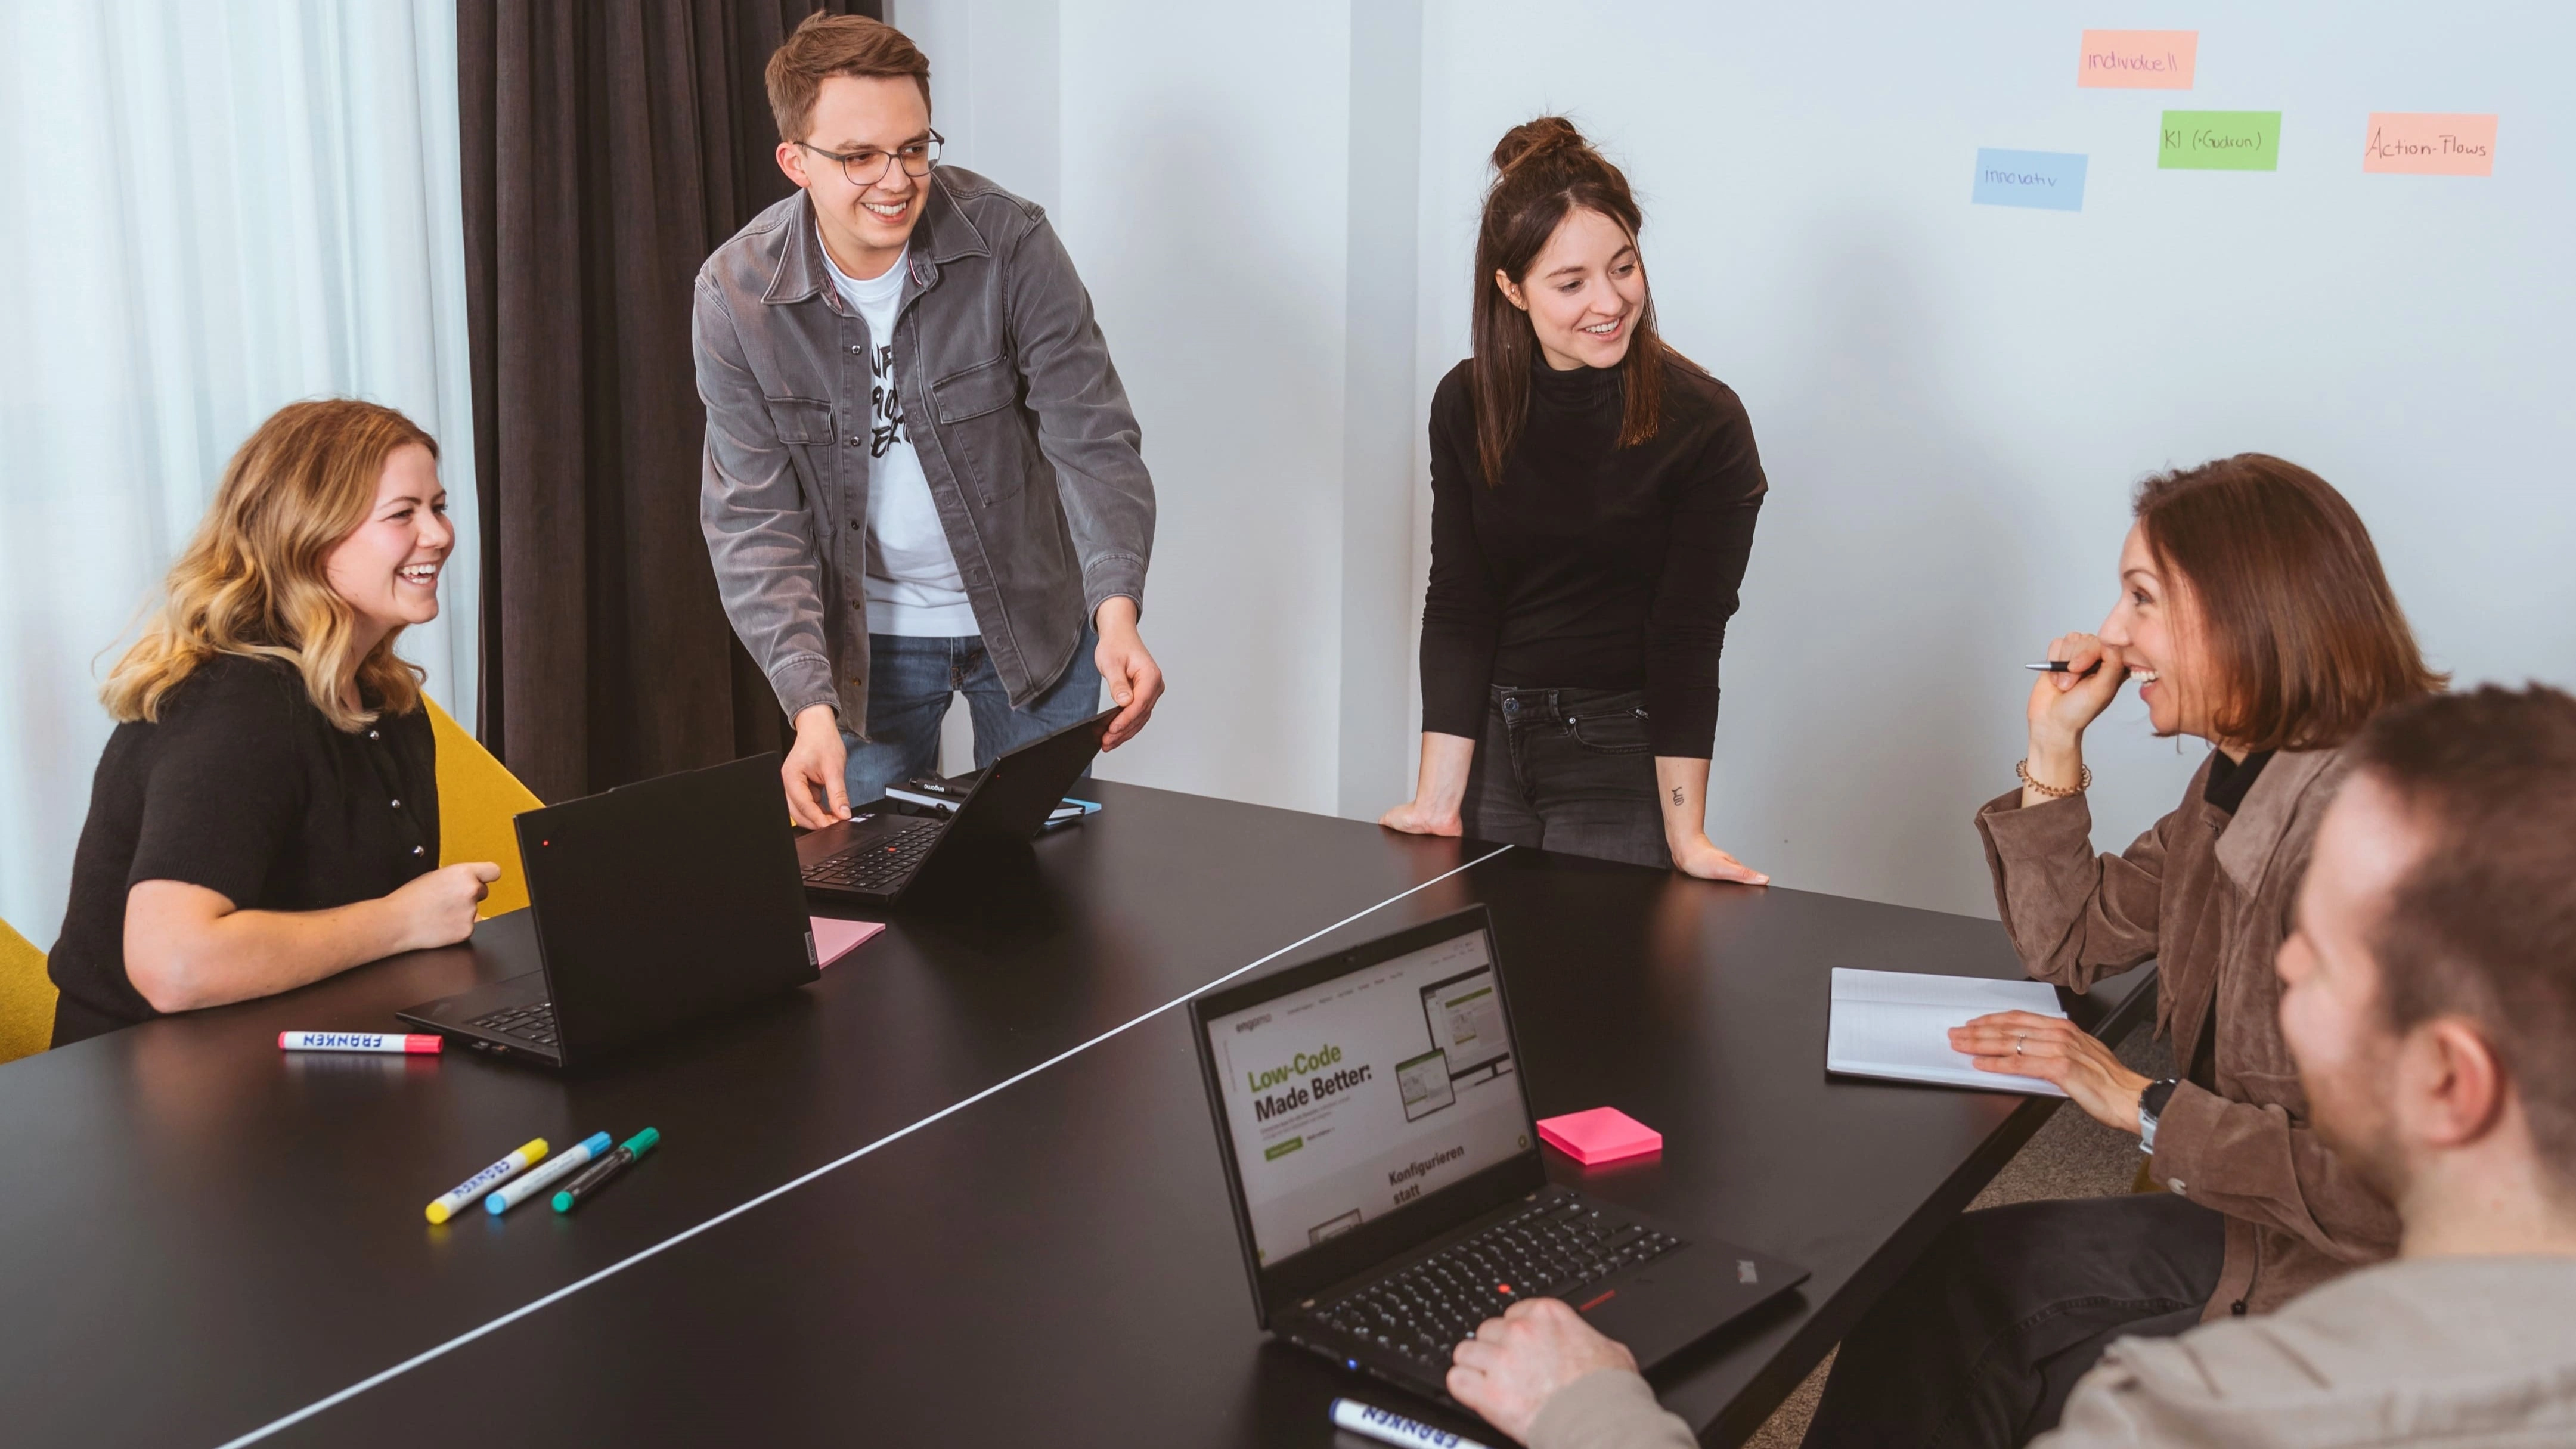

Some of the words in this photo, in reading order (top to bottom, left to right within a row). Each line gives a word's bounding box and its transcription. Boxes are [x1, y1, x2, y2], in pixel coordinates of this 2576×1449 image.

[2165, 129, 2180, 149] KI
[2366, 126, 2486, 159] Action-Flows
[807, 934, 816, 963] Lenovo
[303, 1034, 383, 1048] FRANKEN
[1248, 1044, 1341, 1093] Low-Code
[1254, 1087, 1309, 1122] Made
[1311, 1064, 1372, 1101] Better:
[1388, 1145, 1464, 1186] Konfigurieren
[1393, 1183, 1421, 1205] statt
